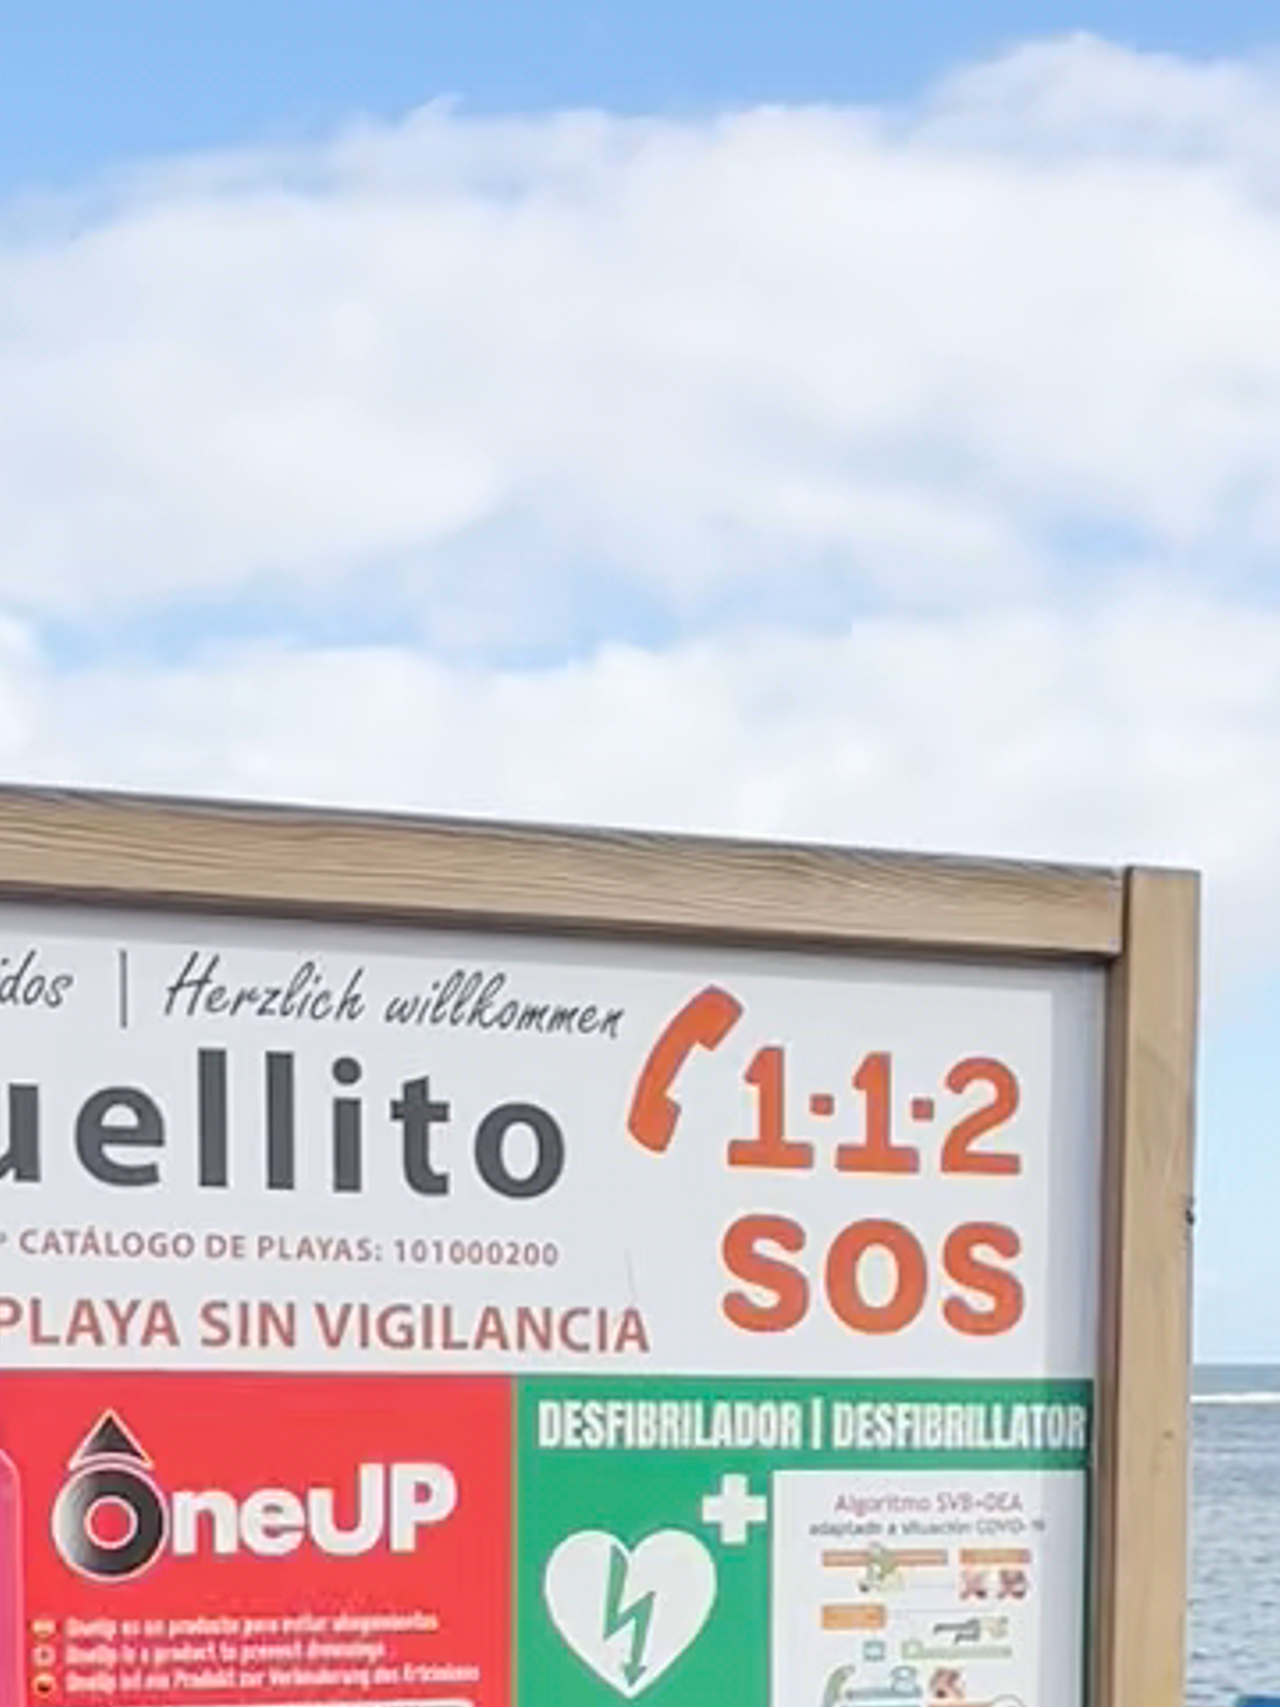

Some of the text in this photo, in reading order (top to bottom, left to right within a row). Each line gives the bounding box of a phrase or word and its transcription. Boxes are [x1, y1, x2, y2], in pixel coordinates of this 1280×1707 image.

[164, 950, 625, 1039] Herzlich willkommen
[18, 1225, 194, 1260] CATÁLOGO
[205, 1234, 247, 1260] DE
[257, 1235, 383, 1263] PLAYAS:
[394, 1238, 560, 1267] 101000200
[722, 1212, 1026, 1337] SOS
[199, 1299, 297, 1351] SIN
[314, 1300, 651, 1354] VIGILANCIA
[537, 1399, 802, 1450] DESFIBRILADOR
